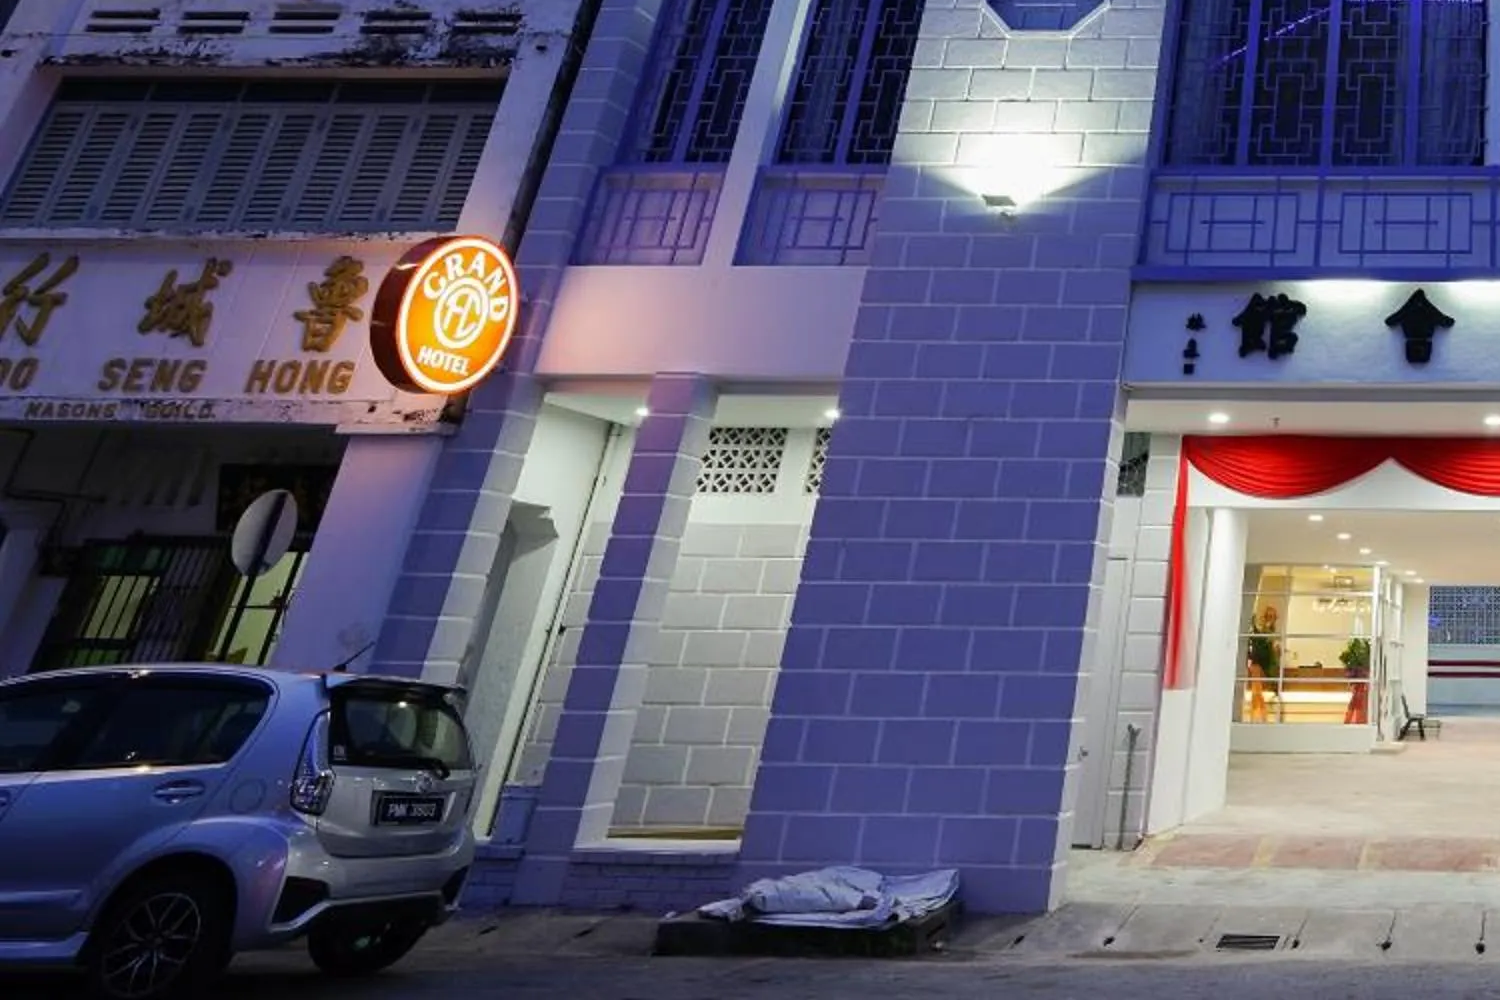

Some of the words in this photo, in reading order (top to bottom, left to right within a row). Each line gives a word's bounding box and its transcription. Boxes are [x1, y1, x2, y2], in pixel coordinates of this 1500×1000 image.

[423, 251, 509, 322] GRAND
[97, 357, 207, 393] SENG
[243, 359, 355, 395] HONG
[417, 345, 470, 377] HOTEL
